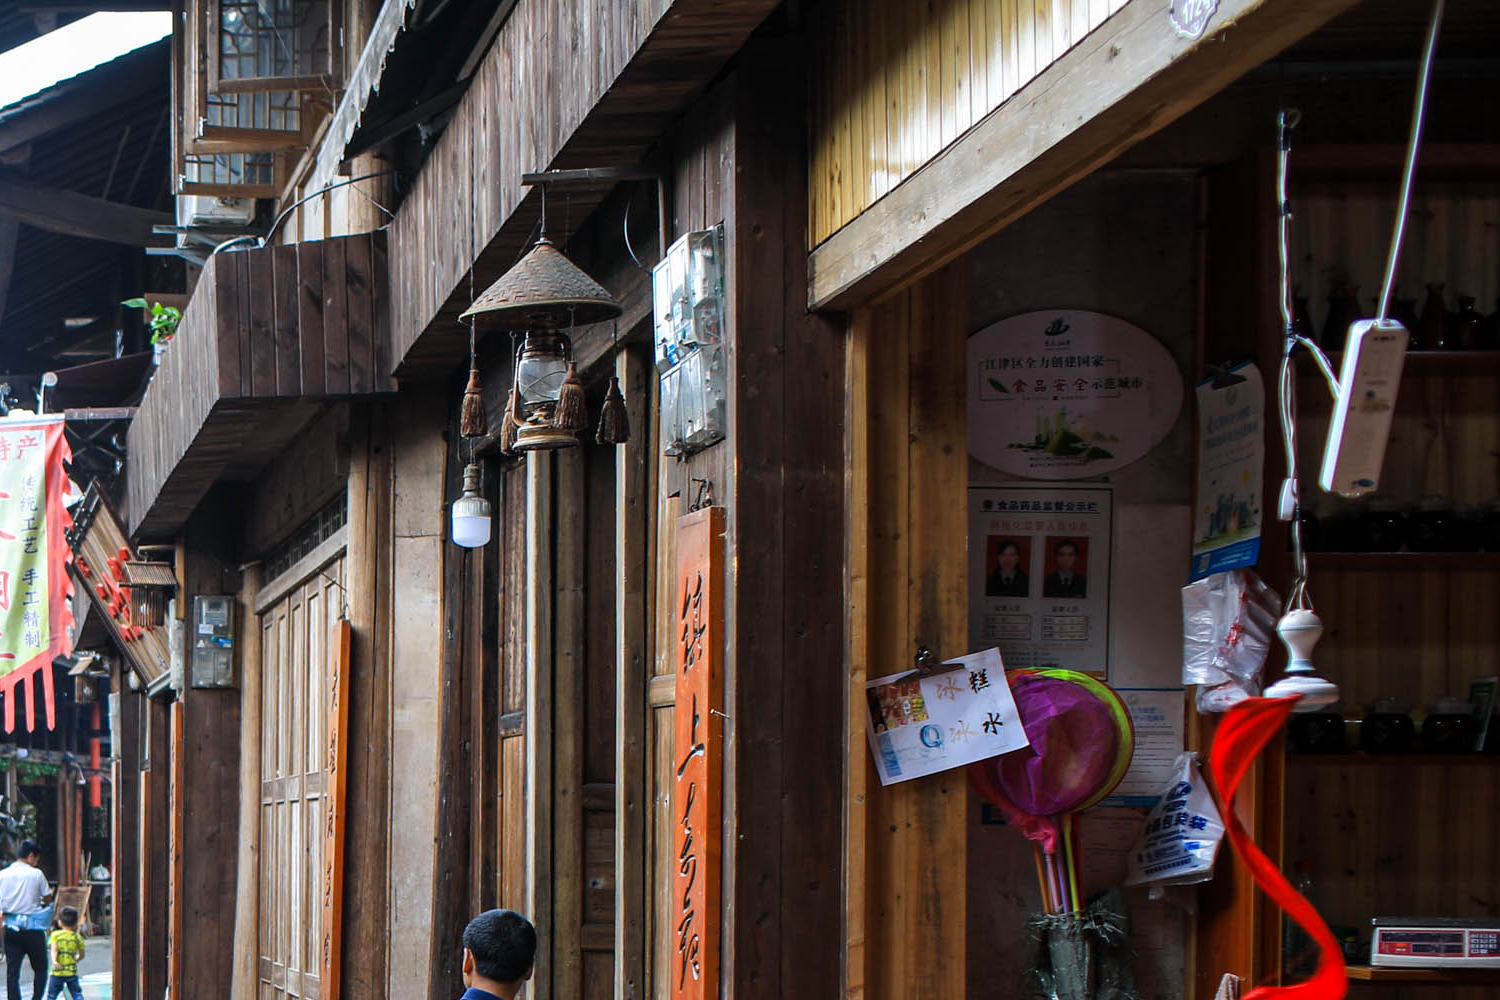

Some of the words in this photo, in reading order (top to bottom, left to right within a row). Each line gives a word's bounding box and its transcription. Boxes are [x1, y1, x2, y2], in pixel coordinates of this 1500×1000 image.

[1012, 376, 1143, 392] 食品安全示范城市
[20, 474, 38, 555] 传统工艺
[22, 568, 40, 648] 手工精制
[936, 668, 991, 700] 冰糕
